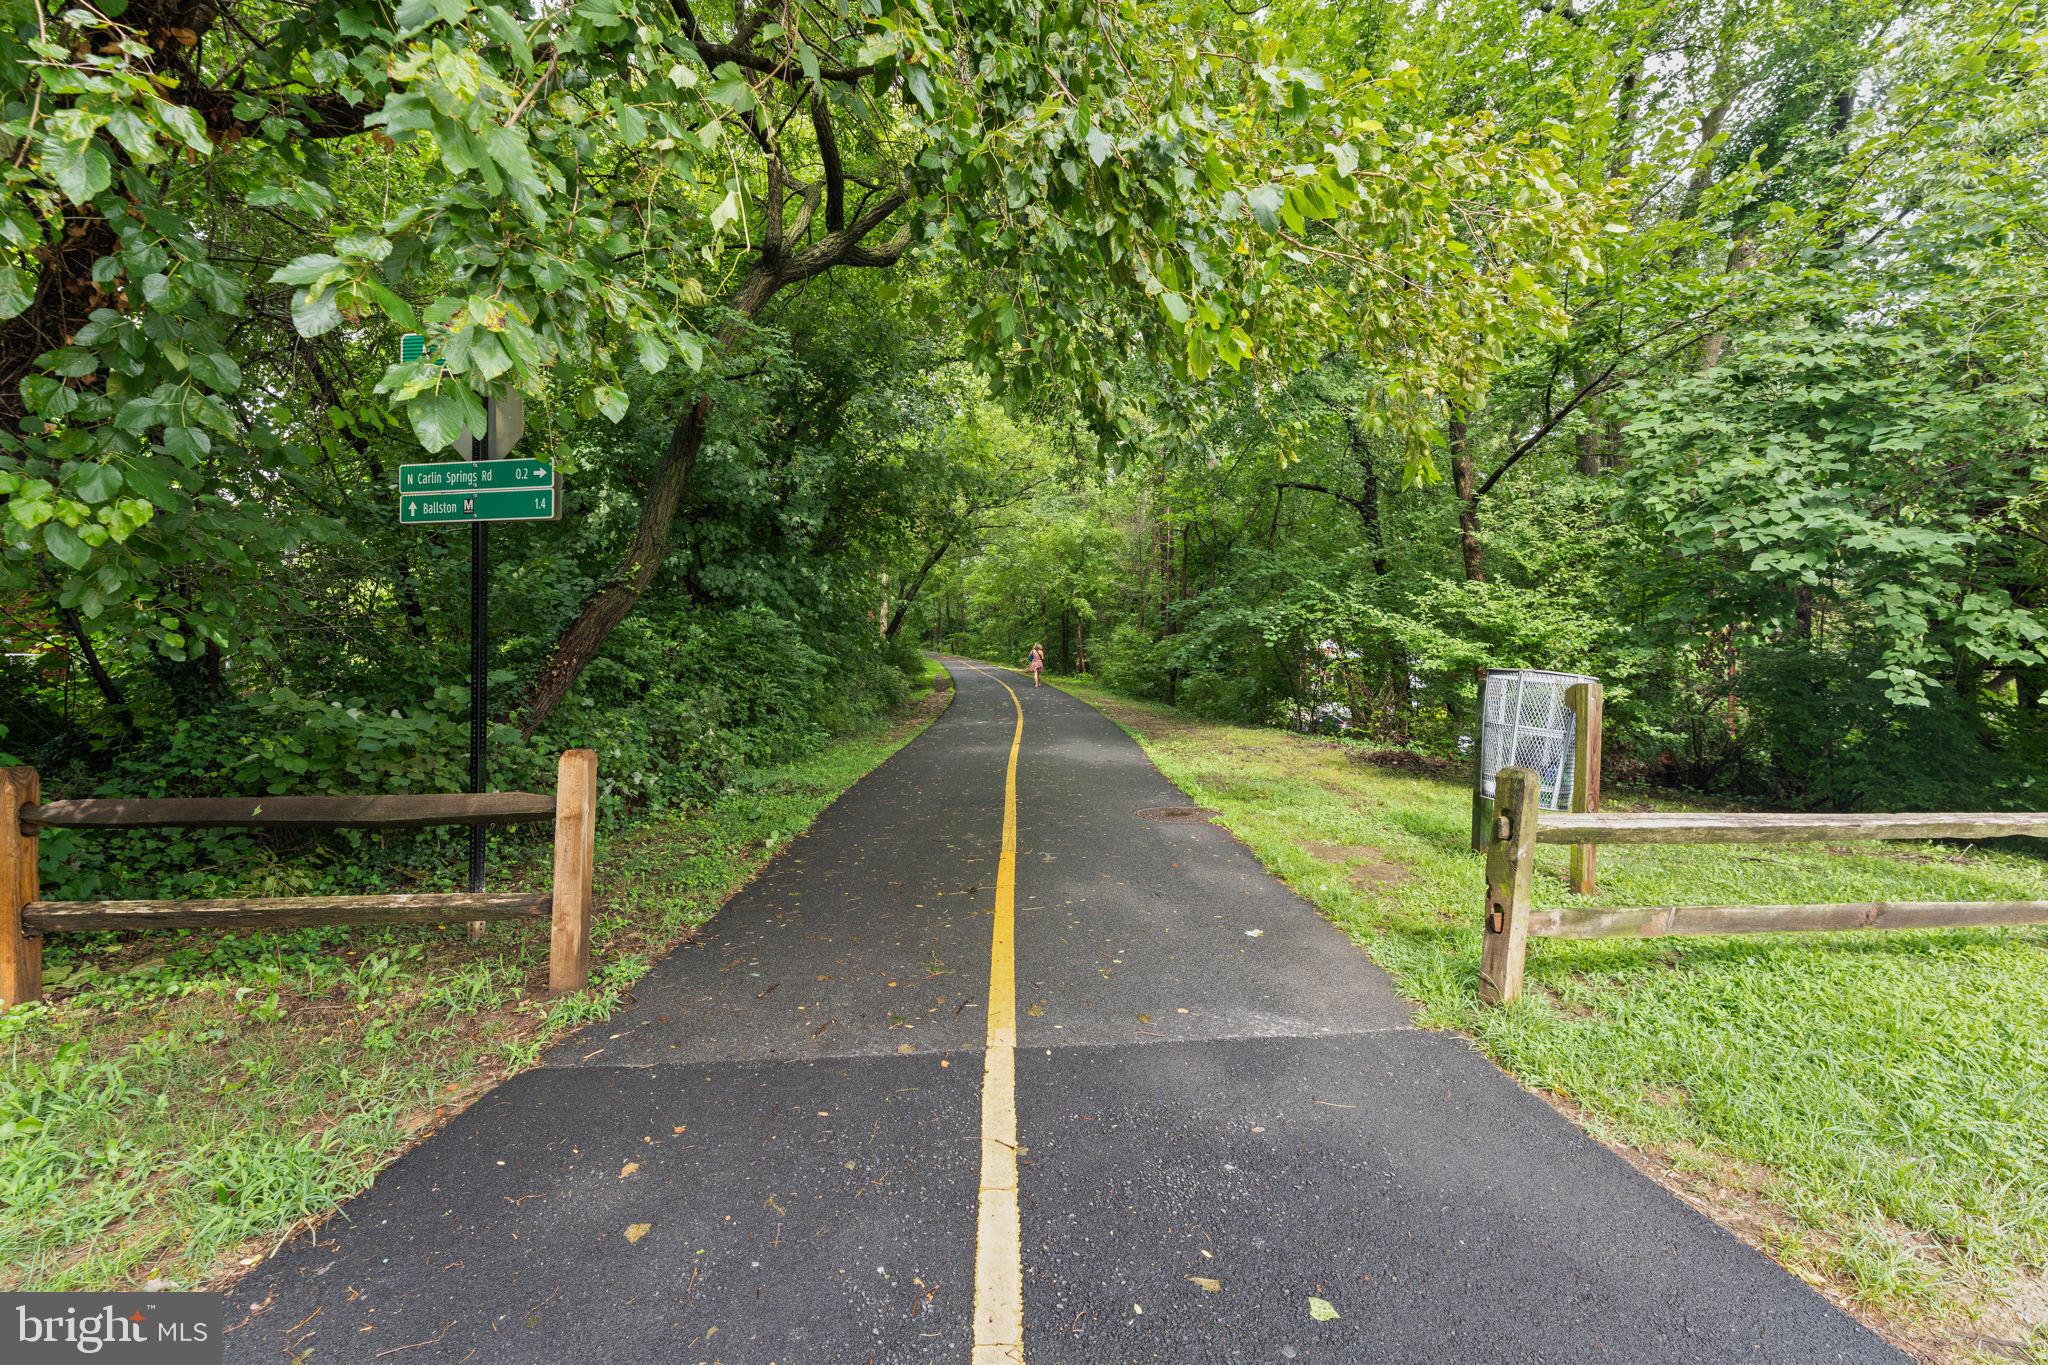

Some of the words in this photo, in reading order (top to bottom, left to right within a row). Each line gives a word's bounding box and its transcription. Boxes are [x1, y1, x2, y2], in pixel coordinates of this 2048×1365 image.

[407, 474, 413, 485] N
[417, 472, 442, 485] Carlin
[446, 471, 477, 486] Springs
[481, 469, 493, 482] Rd
[515, 468, 528, 480] 0.2
[423, 502, 457, 514] Ballston
[534, 498, 546, 510] 1.4
